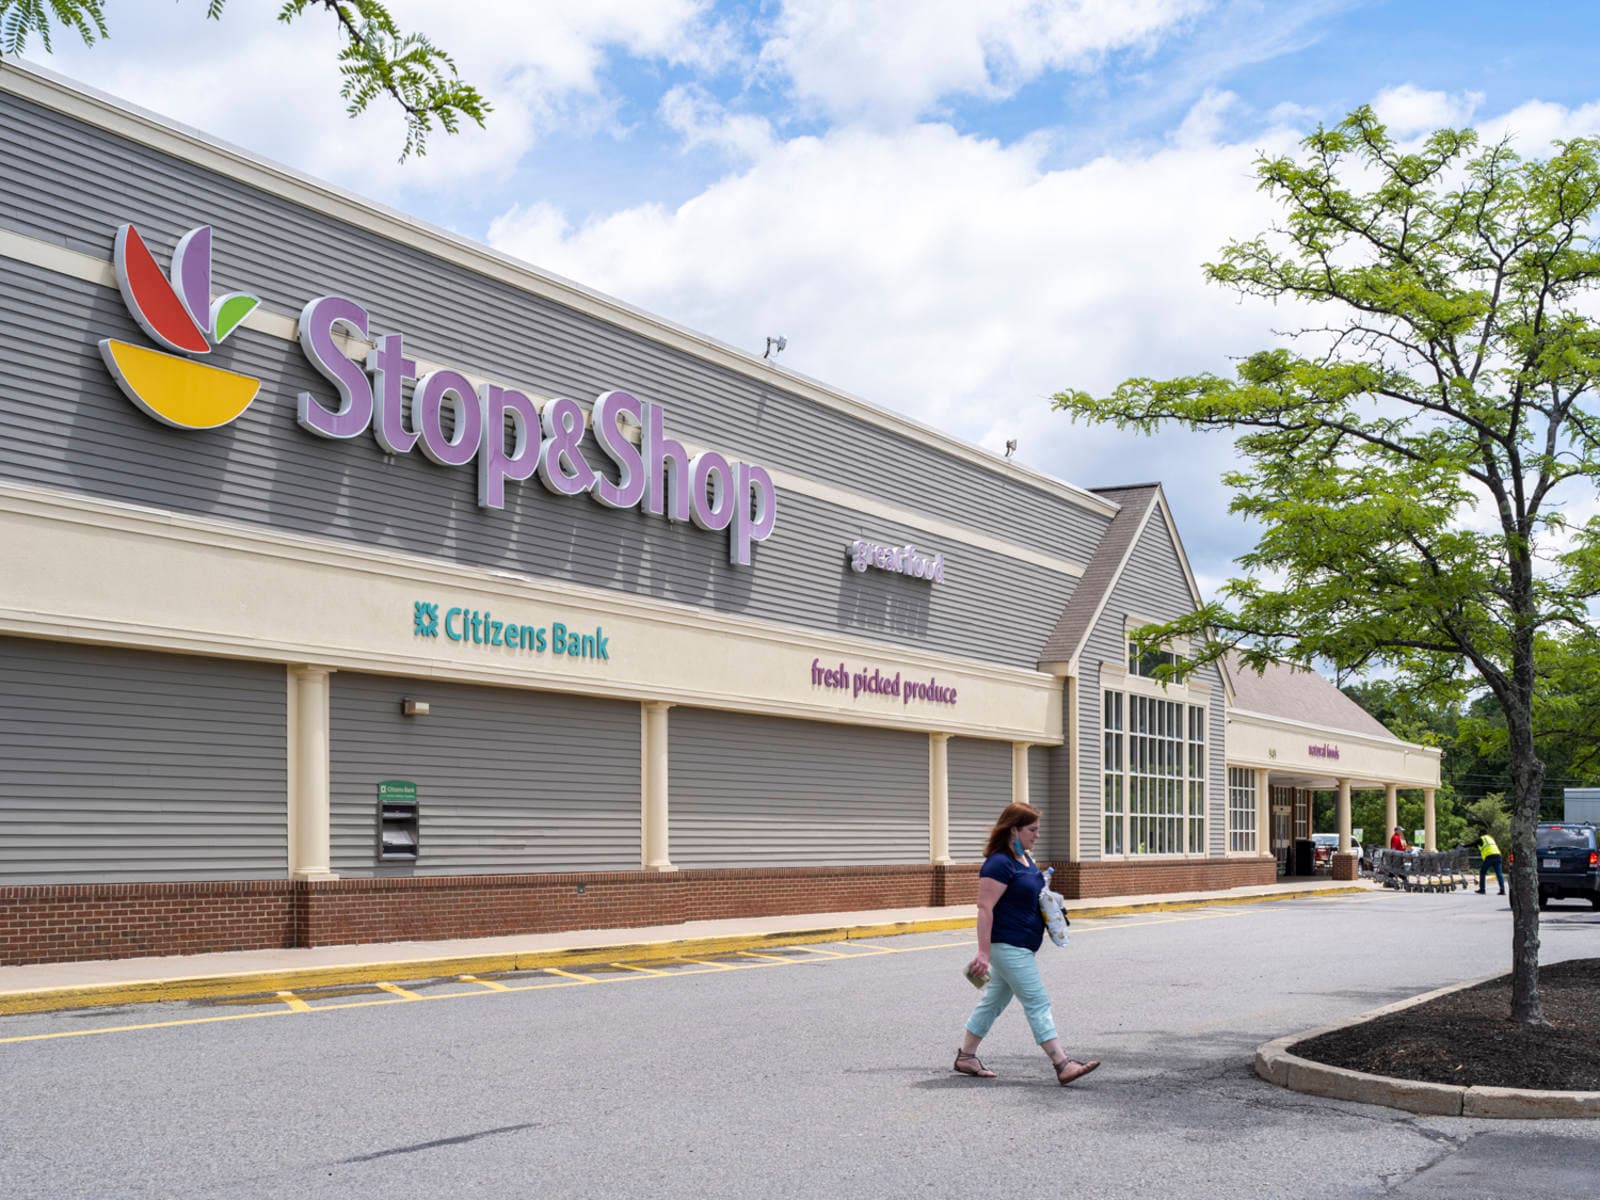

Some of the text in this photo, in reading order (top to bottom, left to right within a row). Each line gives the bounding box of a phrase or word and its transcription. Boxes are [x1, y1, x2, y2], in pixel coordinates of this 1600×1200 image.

[851, 540, 945, 584] great food
[445, 607, 609, 660] Citizens Bank
[811, 658, 957, 704] fresh picked produce
